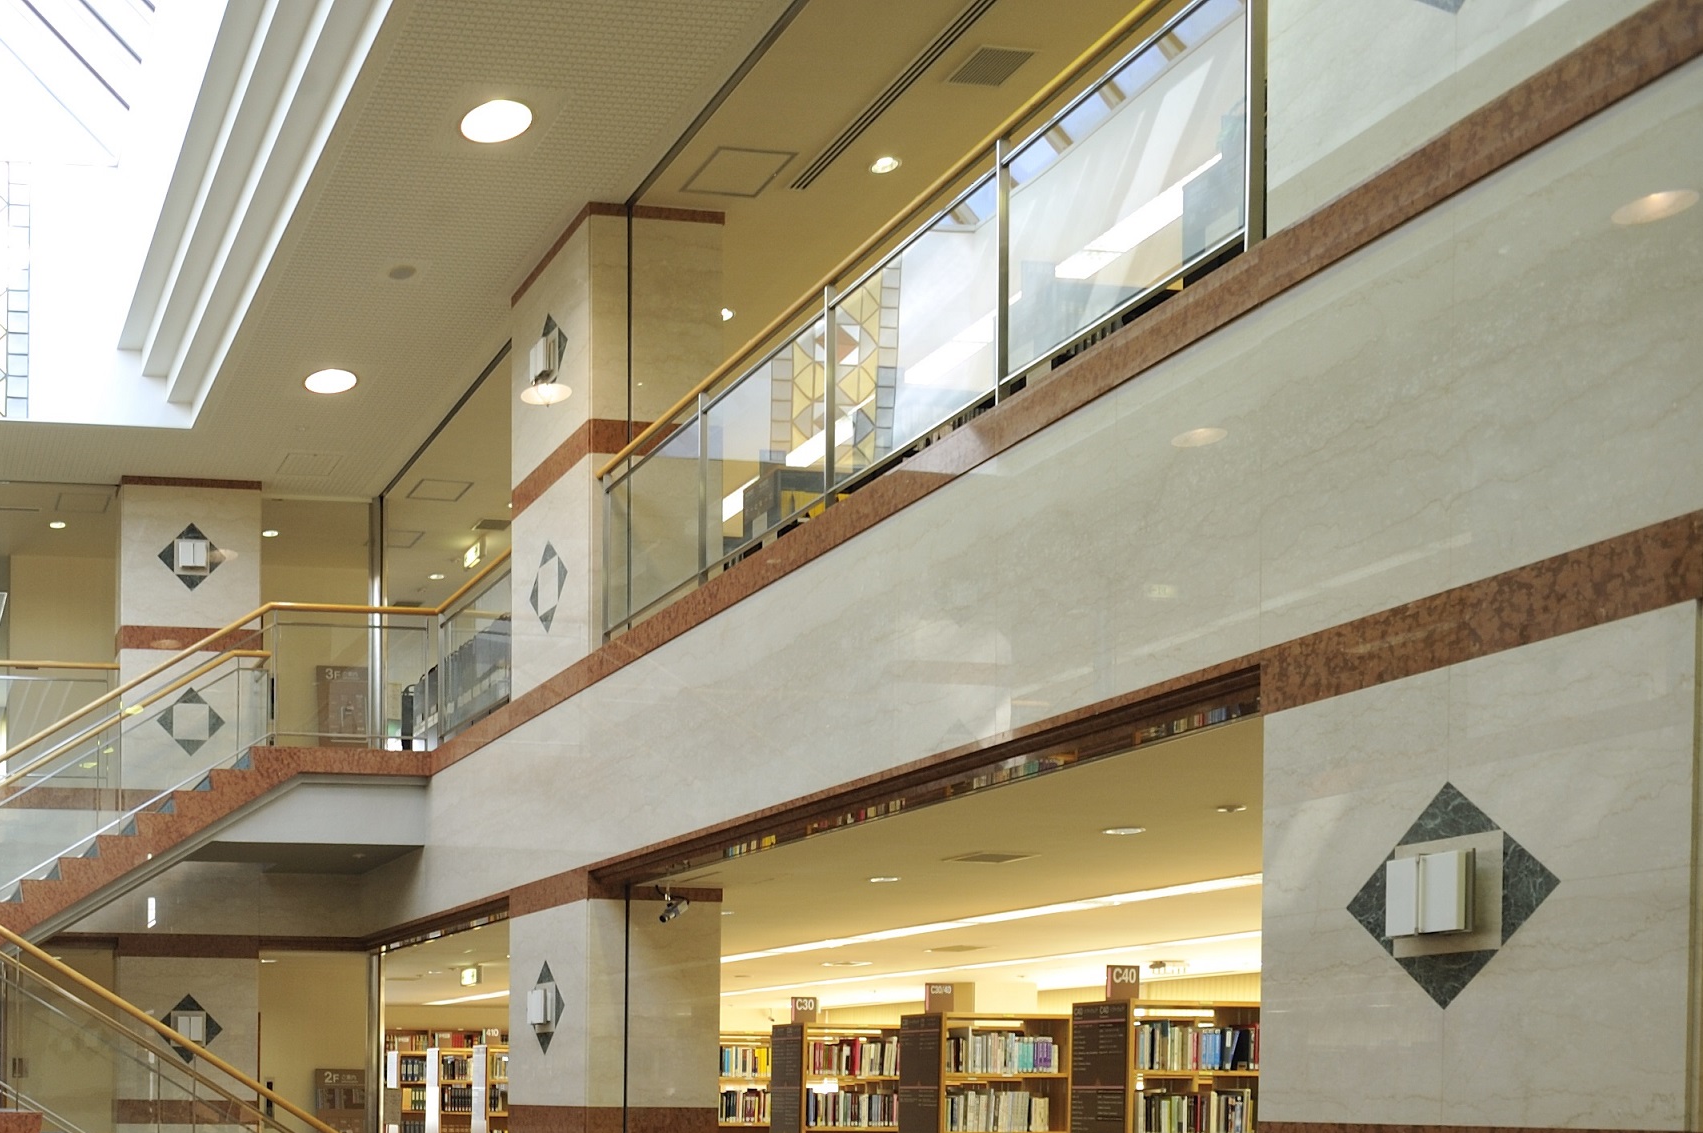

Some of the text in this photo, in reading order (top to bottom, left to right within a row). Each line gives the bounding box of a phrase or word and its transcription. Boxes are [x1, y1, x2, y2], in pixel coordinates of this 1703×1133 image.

[325, 667, 341, 680] 3F
[1112, 967, 1136, 984] C40
[796, 998, 815, 1011] C30
[485, 1028, 500, 1037] 410
[324, 1071, 340, 1083] 2F
